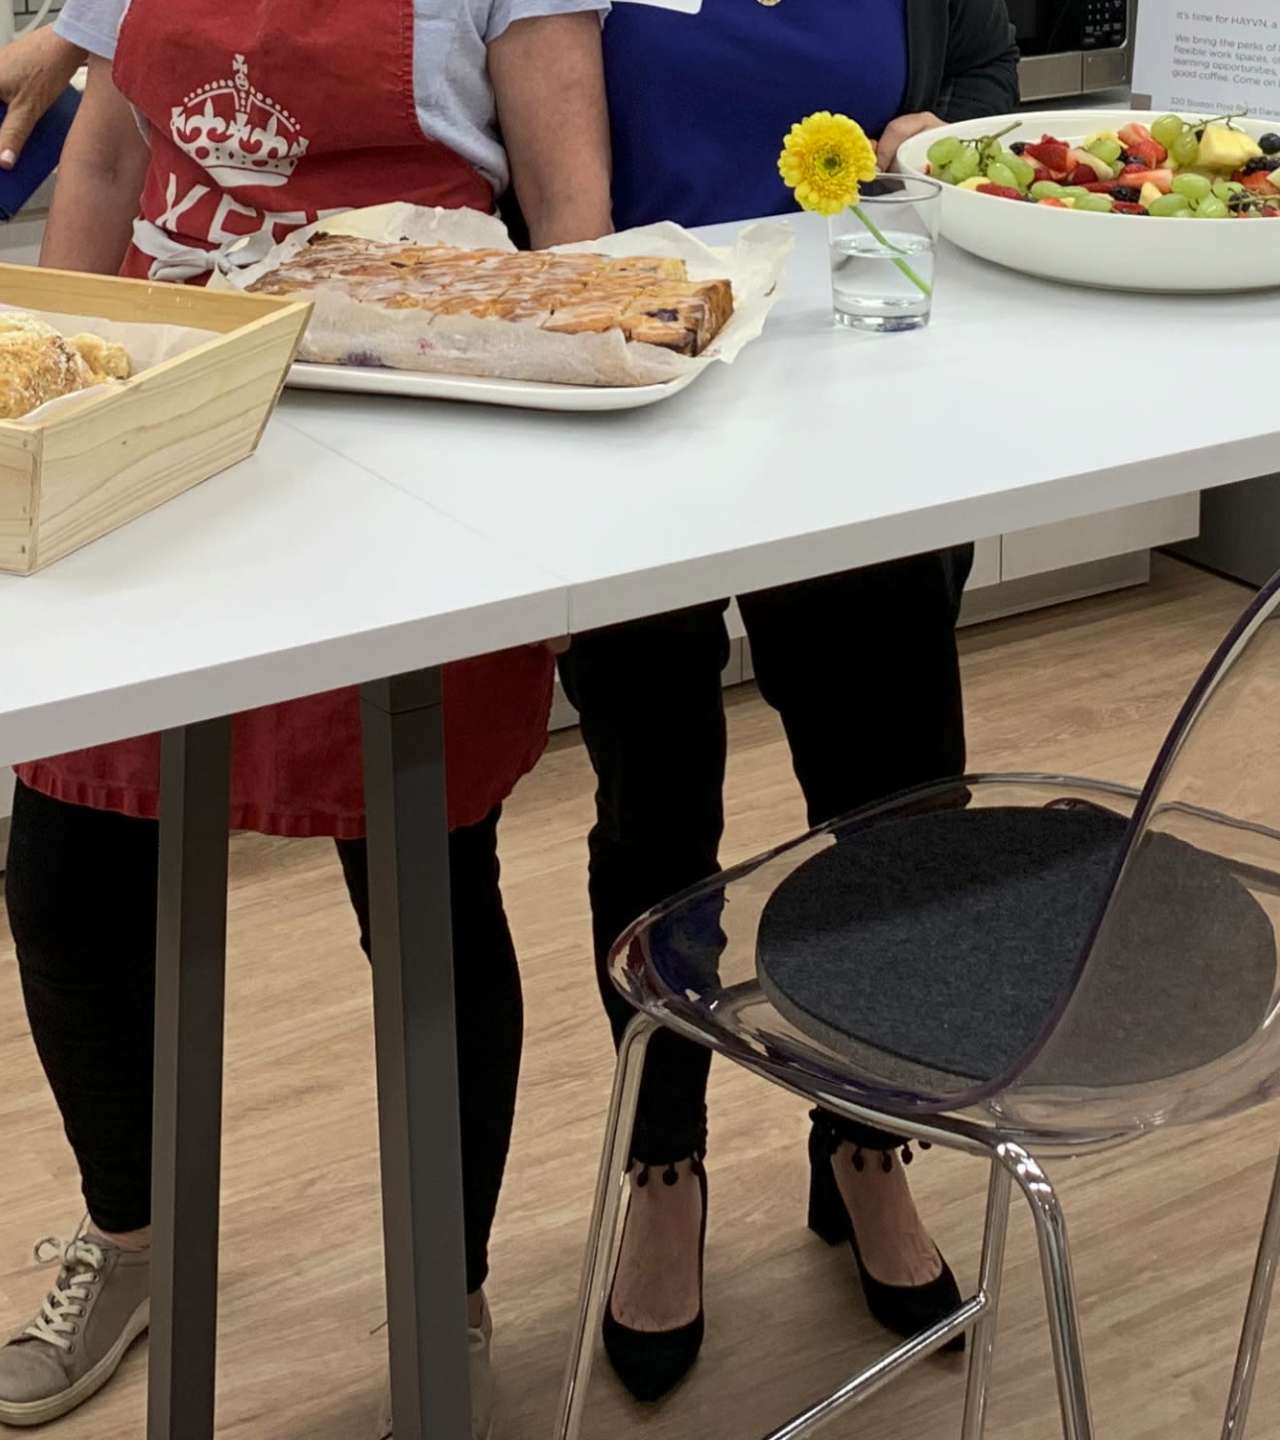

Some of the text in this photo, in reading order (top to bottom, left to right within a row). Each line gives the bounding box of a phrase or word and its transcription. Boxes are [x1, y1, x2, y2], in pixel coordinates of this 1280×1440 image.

[1215, 15, 1229, 24] for
[1175, 33, 1190, 43] We
[1192, 35, 1217, 48] bring
[1219, 38, 1235, 49] the
[1237, 40, 1264, 52] perks
[1265, 42, 1277, 52] of
[1209, 49, 1232, 59] work
[1171, 68, 1197, 80] good
[1232, 73, 1261, 85] Come
[1263, 78, 1276, 87] on
